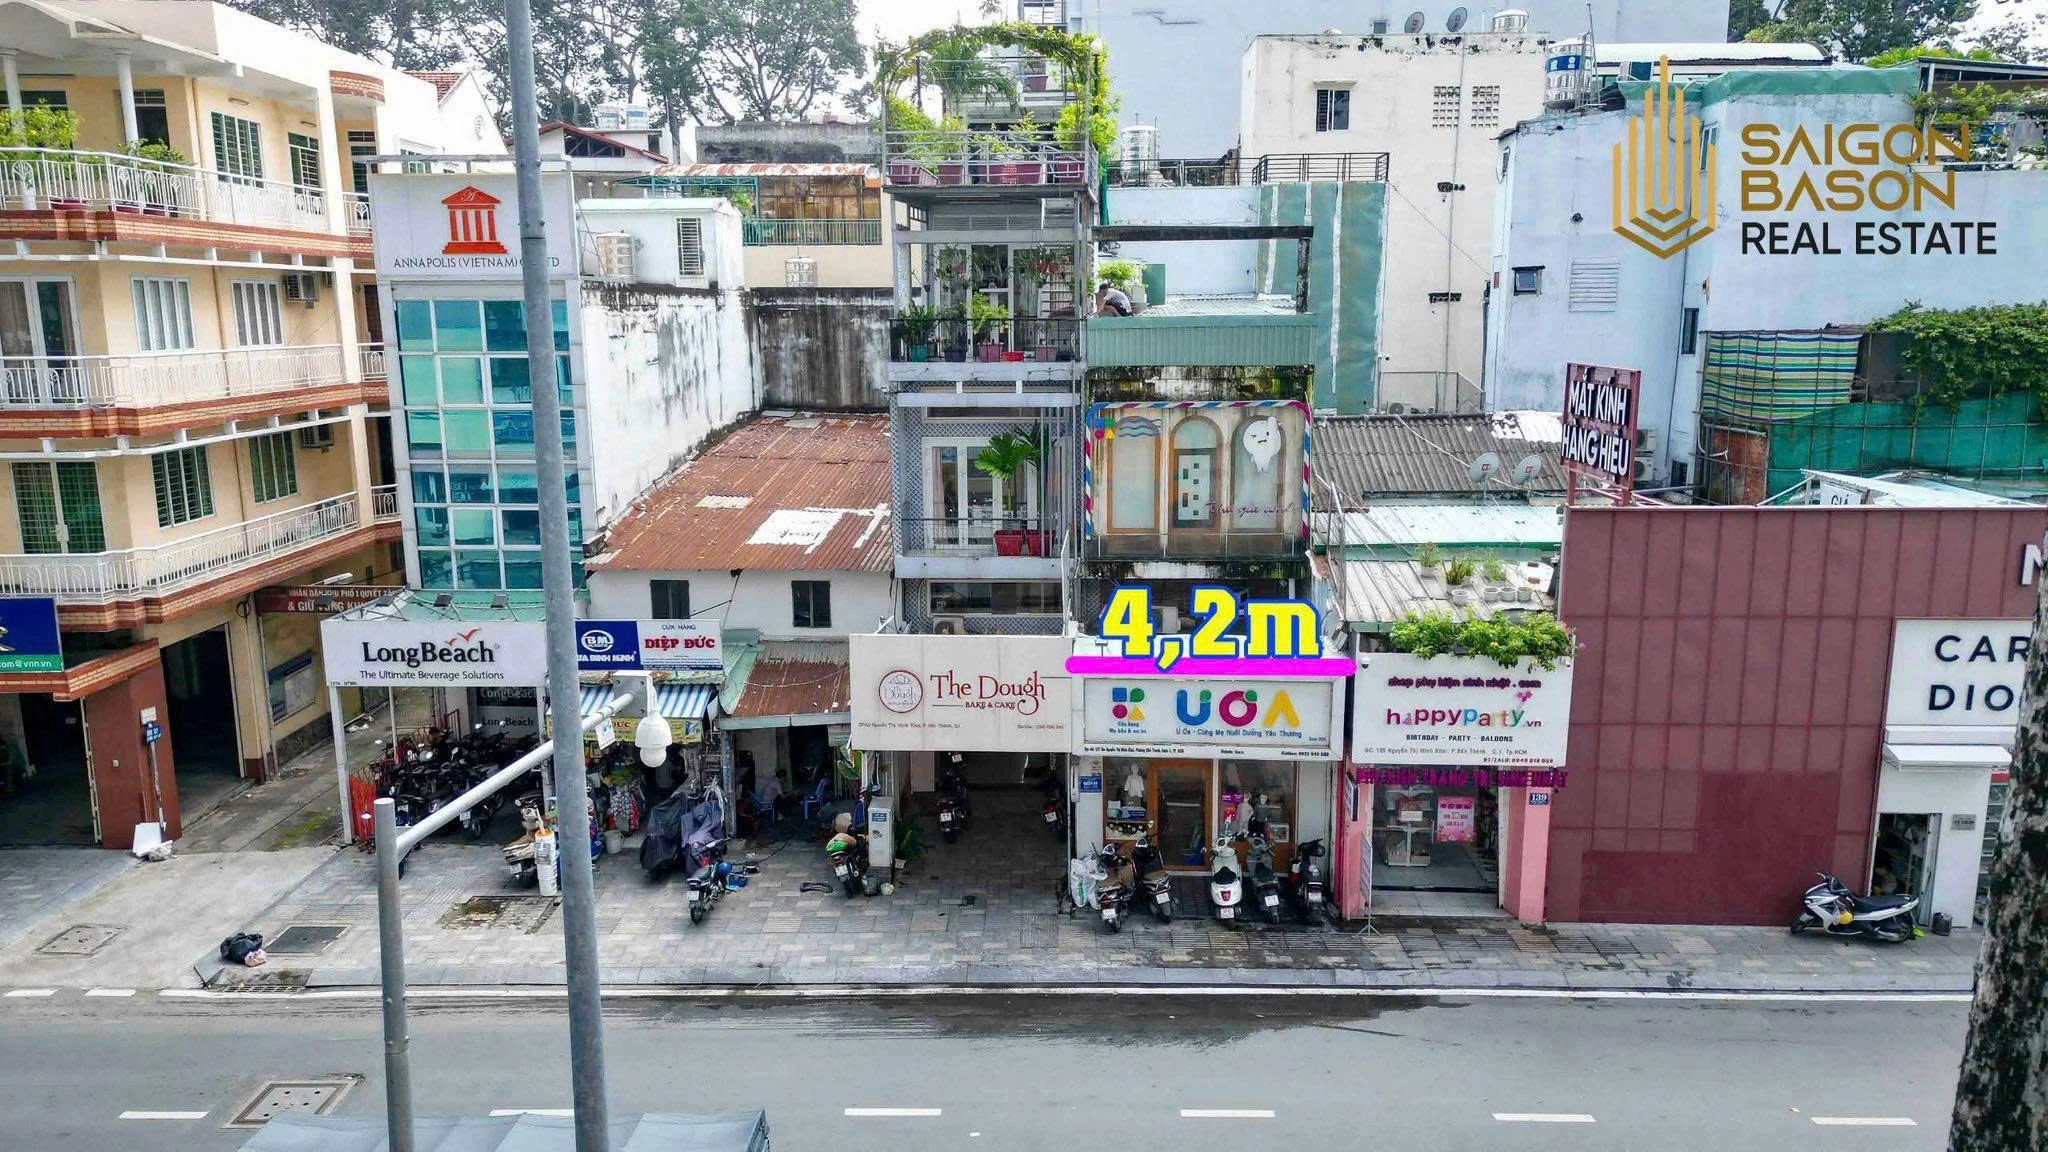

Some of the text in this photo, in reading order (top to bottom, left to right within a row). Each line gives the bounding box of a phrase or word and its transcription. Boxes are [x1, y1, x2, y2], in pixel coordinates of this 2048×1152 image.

[394, 257, 456, 268] ANNAPOLIS
[458, 256, 518, 268] (VIETNAM)
[1568, 368, 1628, 425] MẮT KÍNH
[1561, 418, 1630, 482] HÀNG HIỆU
[287, 601, 296, 612] &
[361, 640, 496, 668] LongBeach
[360, 670, 504, 681] The Ultimate Beverage Solutions
[930, 670, 1046, 716] The Dough
[964, 701, 1016, 709] BAKE & CAKE
[480, 716, 534, 729] LonBeach
[1197, 728, 1213, 737] Cùng
[1226, 728, 1241, 736] Nuôi
[1243, 728, 1262, 738] Dưỡng
[1265, 729, 1277, 737] Yêu
[1279, 729, 1302, 739] Thương
[1405, 734, 1440, 742] BIRTHDAY
[1448, 735, 1472, 743] PARTY
[1531, 793, 1548, 801] 139
